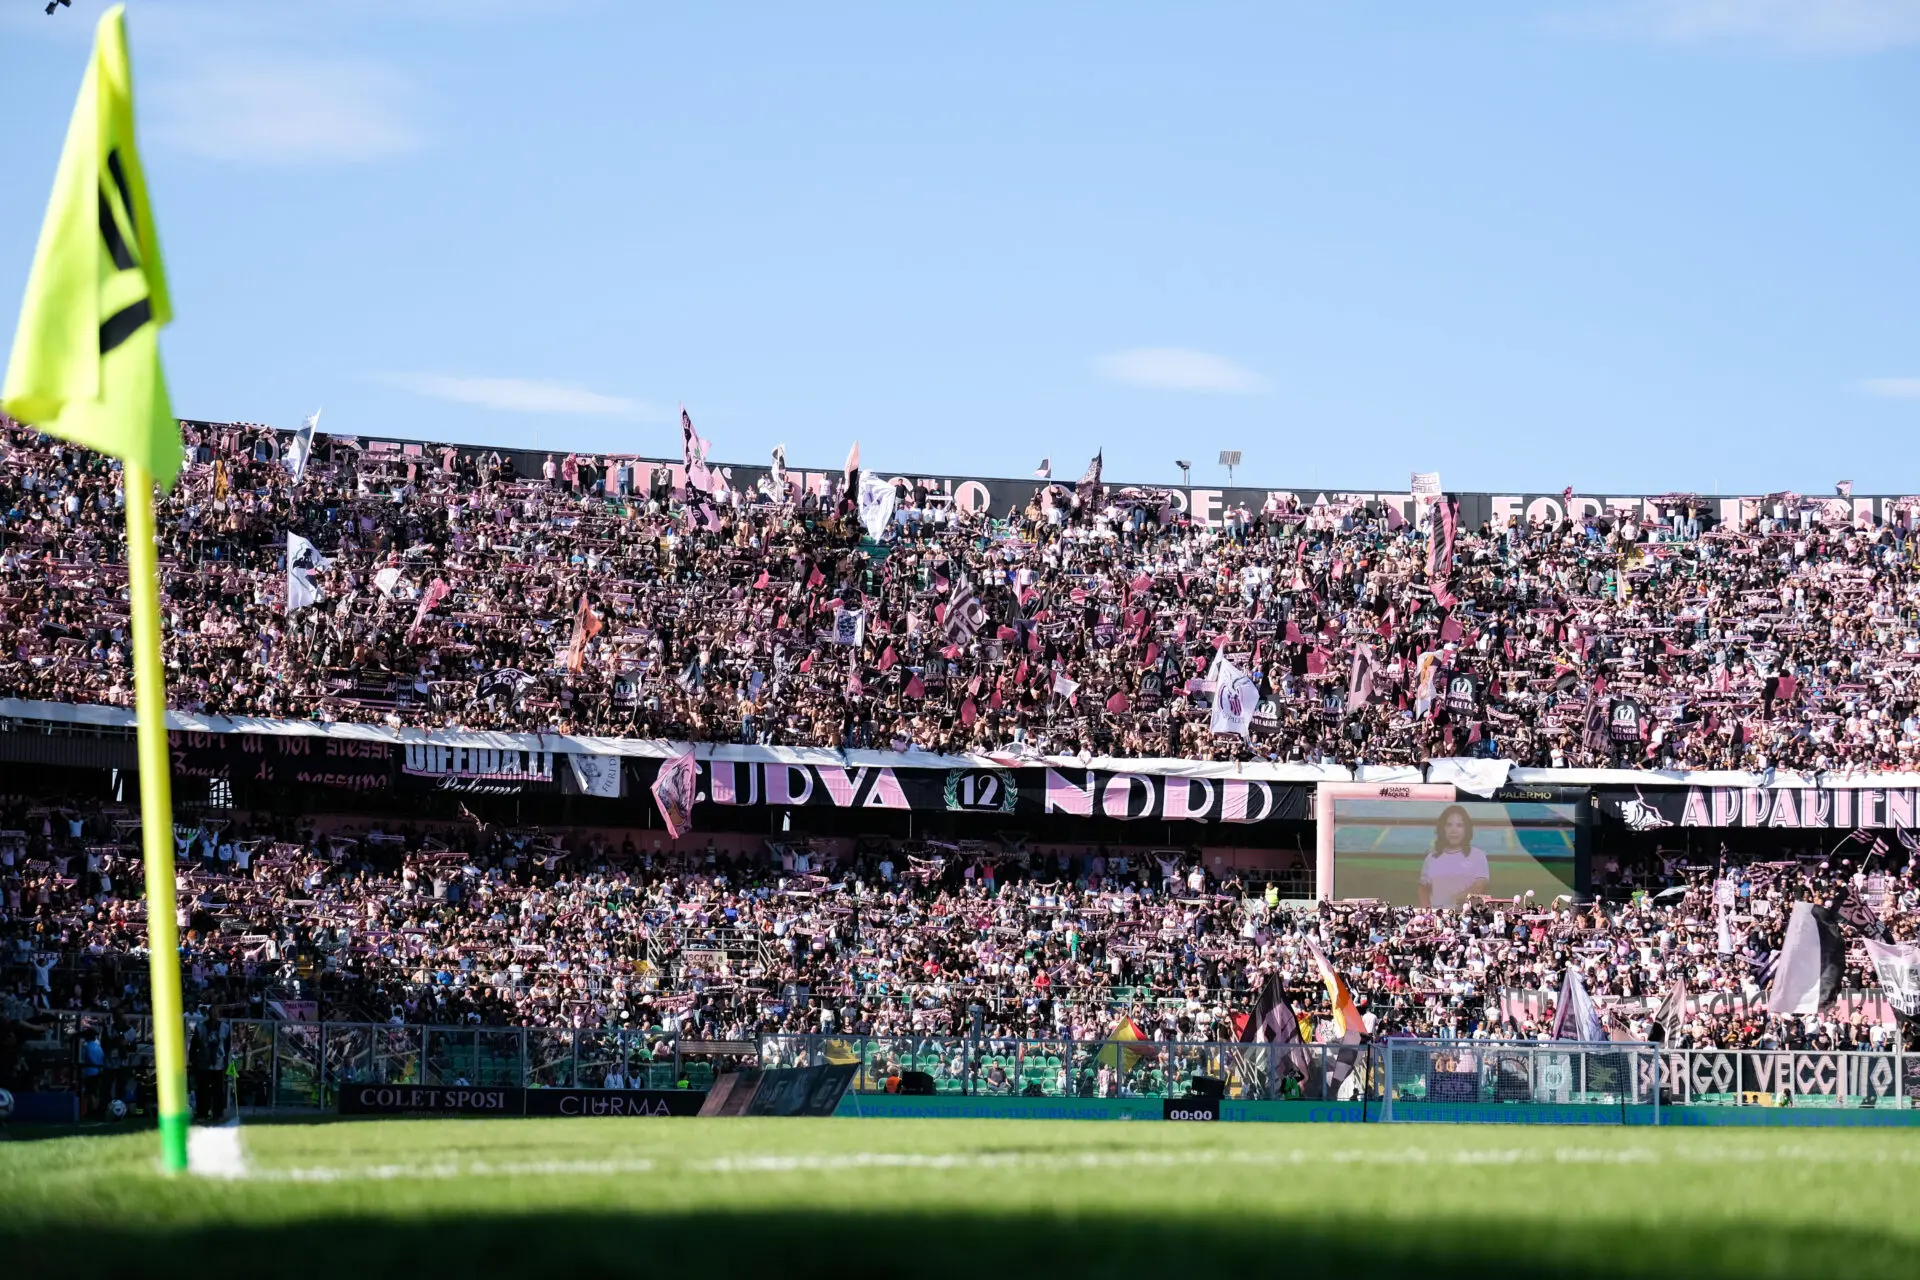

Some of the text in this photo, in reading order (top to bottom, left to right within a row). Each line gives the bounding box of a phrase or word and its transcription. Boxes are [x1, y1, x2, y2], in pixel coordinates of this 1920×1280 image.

[436, 775, 521, 796] Palermo
[961, 774, 999, 807] 12
[1045, 767, 1273, 824] NORD
[1499, 791, 1552, 800] PALERMO
[1680, 784, 1920, 829] APPARTEN
[682, 954, 714, 962] USCITA
[1640, 1053, 1735, 1095] BORGO
[360, 1088, 504, 1109] COLET SPOSI
[559, 1096, 671, 1117] CIURMA
[1031, 1107, 1109, 1120] TERRASINI
[1170, 1110, 1213, 1120] 00:00
